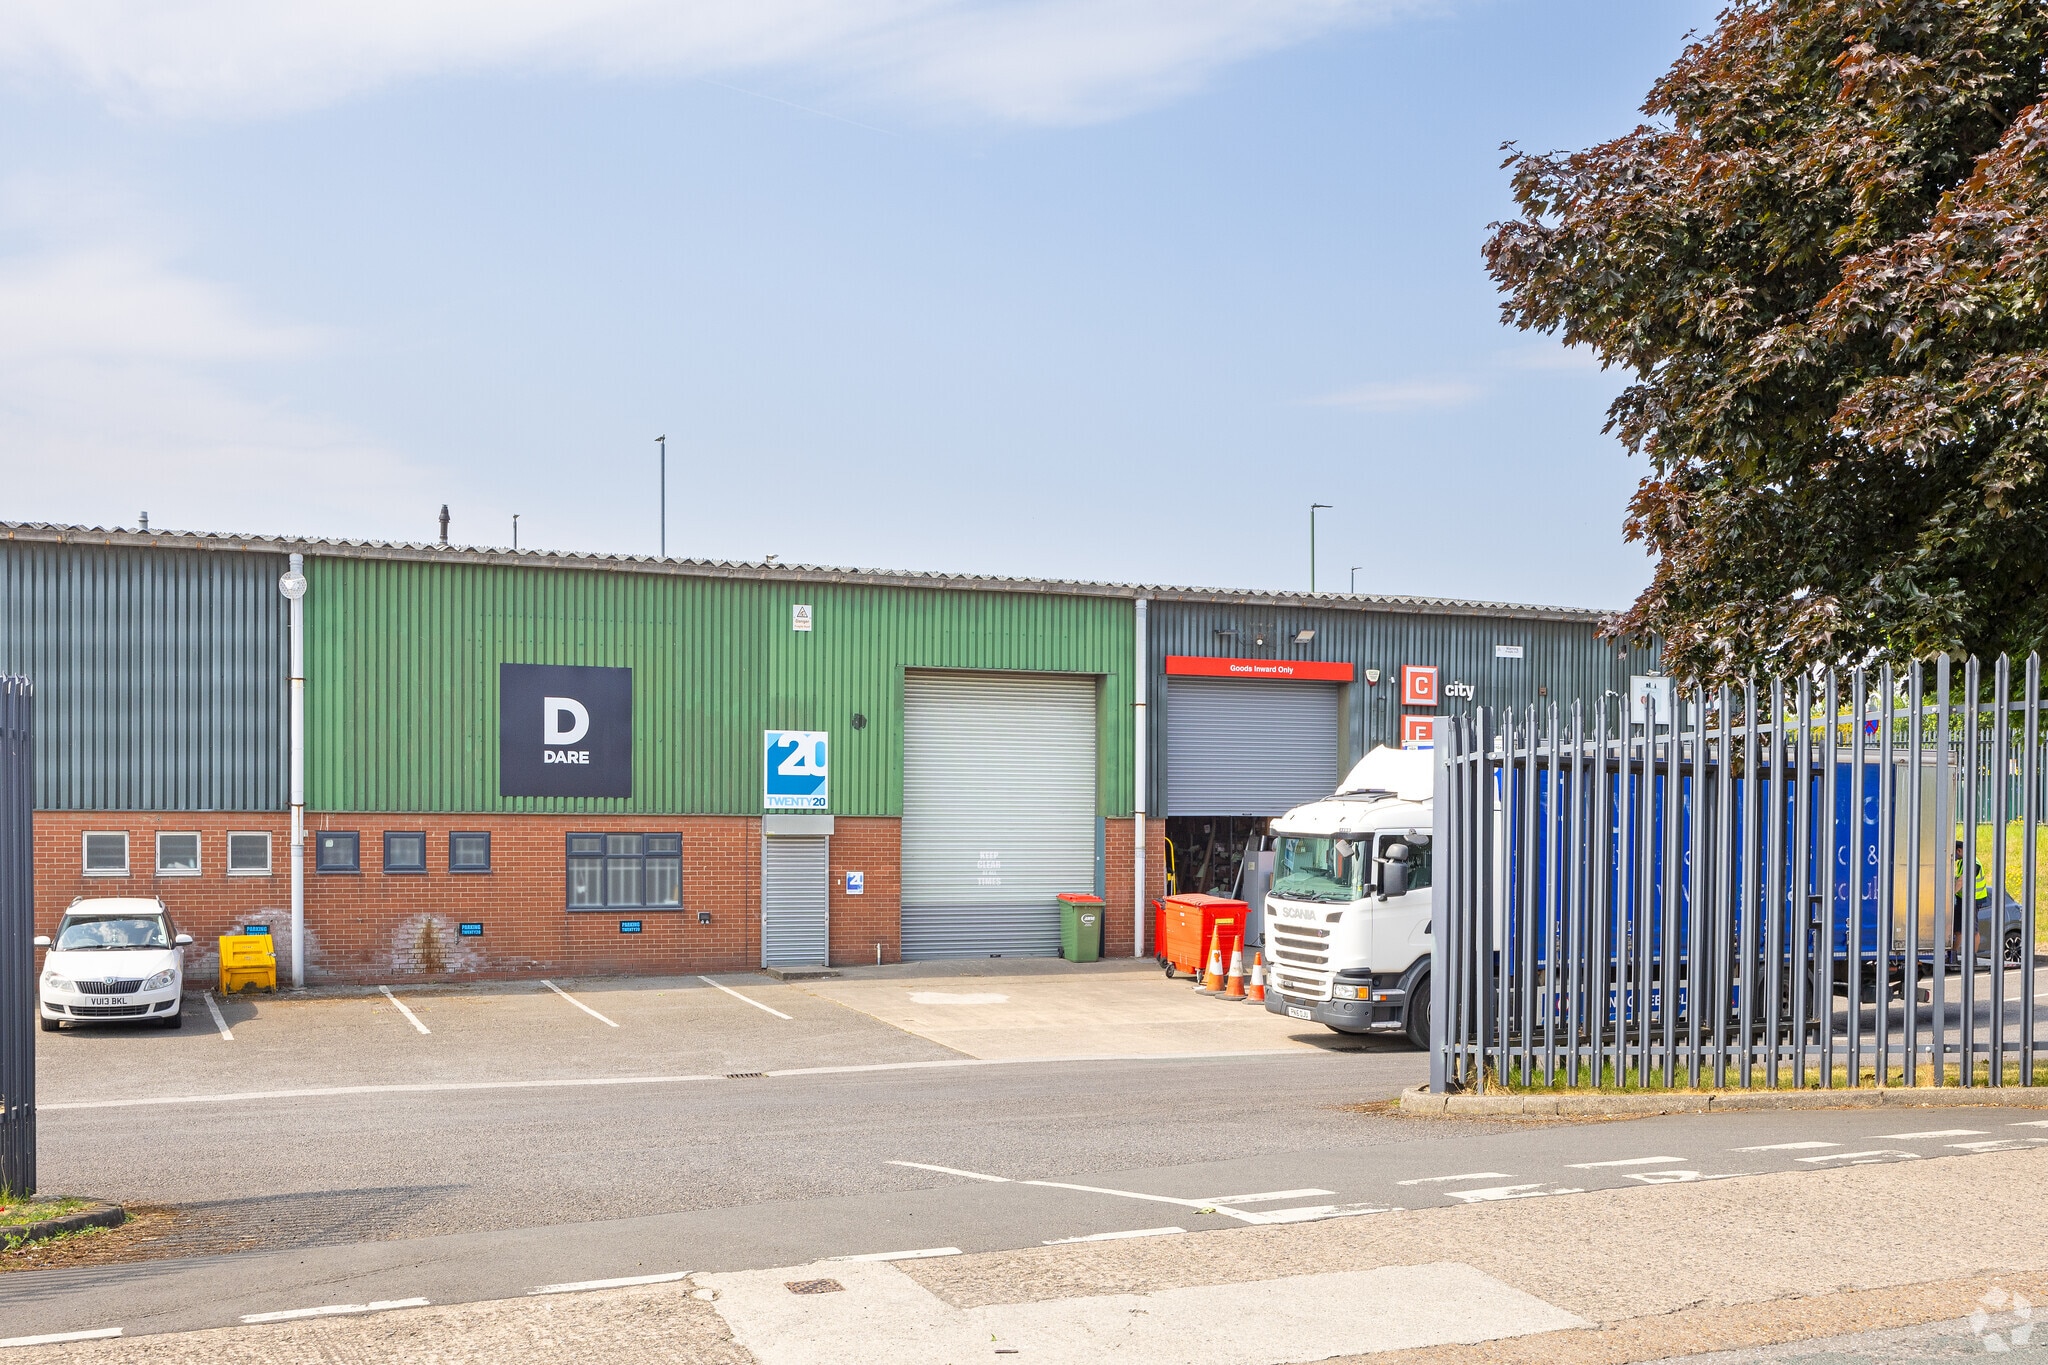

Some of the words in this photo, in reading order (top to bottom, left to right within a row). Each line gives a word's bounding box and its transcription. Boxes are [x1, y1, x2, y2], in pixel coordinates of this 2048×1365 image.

[1229, 664, 1253, 672] Goods
[1254, 665, 1277, 673] Inward
[1278, 666, 1294, 675] Only
[1415, 676, 1428, 694] C
[1445, 681, 1475, 701] city
[544, 696, 590, 745] D
[544, 750, 590, 764] DARE
[777, 732, 826, 776] 20
[979, 851, 999, 859] KEEP
[977, 860, 1001, 869] CLEAR
[977, 877, 1002, 886] TIMES
[1282, 907, 1317, 920] SCANIA
[91, 997, 110, 1006] VU13
[111, 997, 128, 1005] BKL
